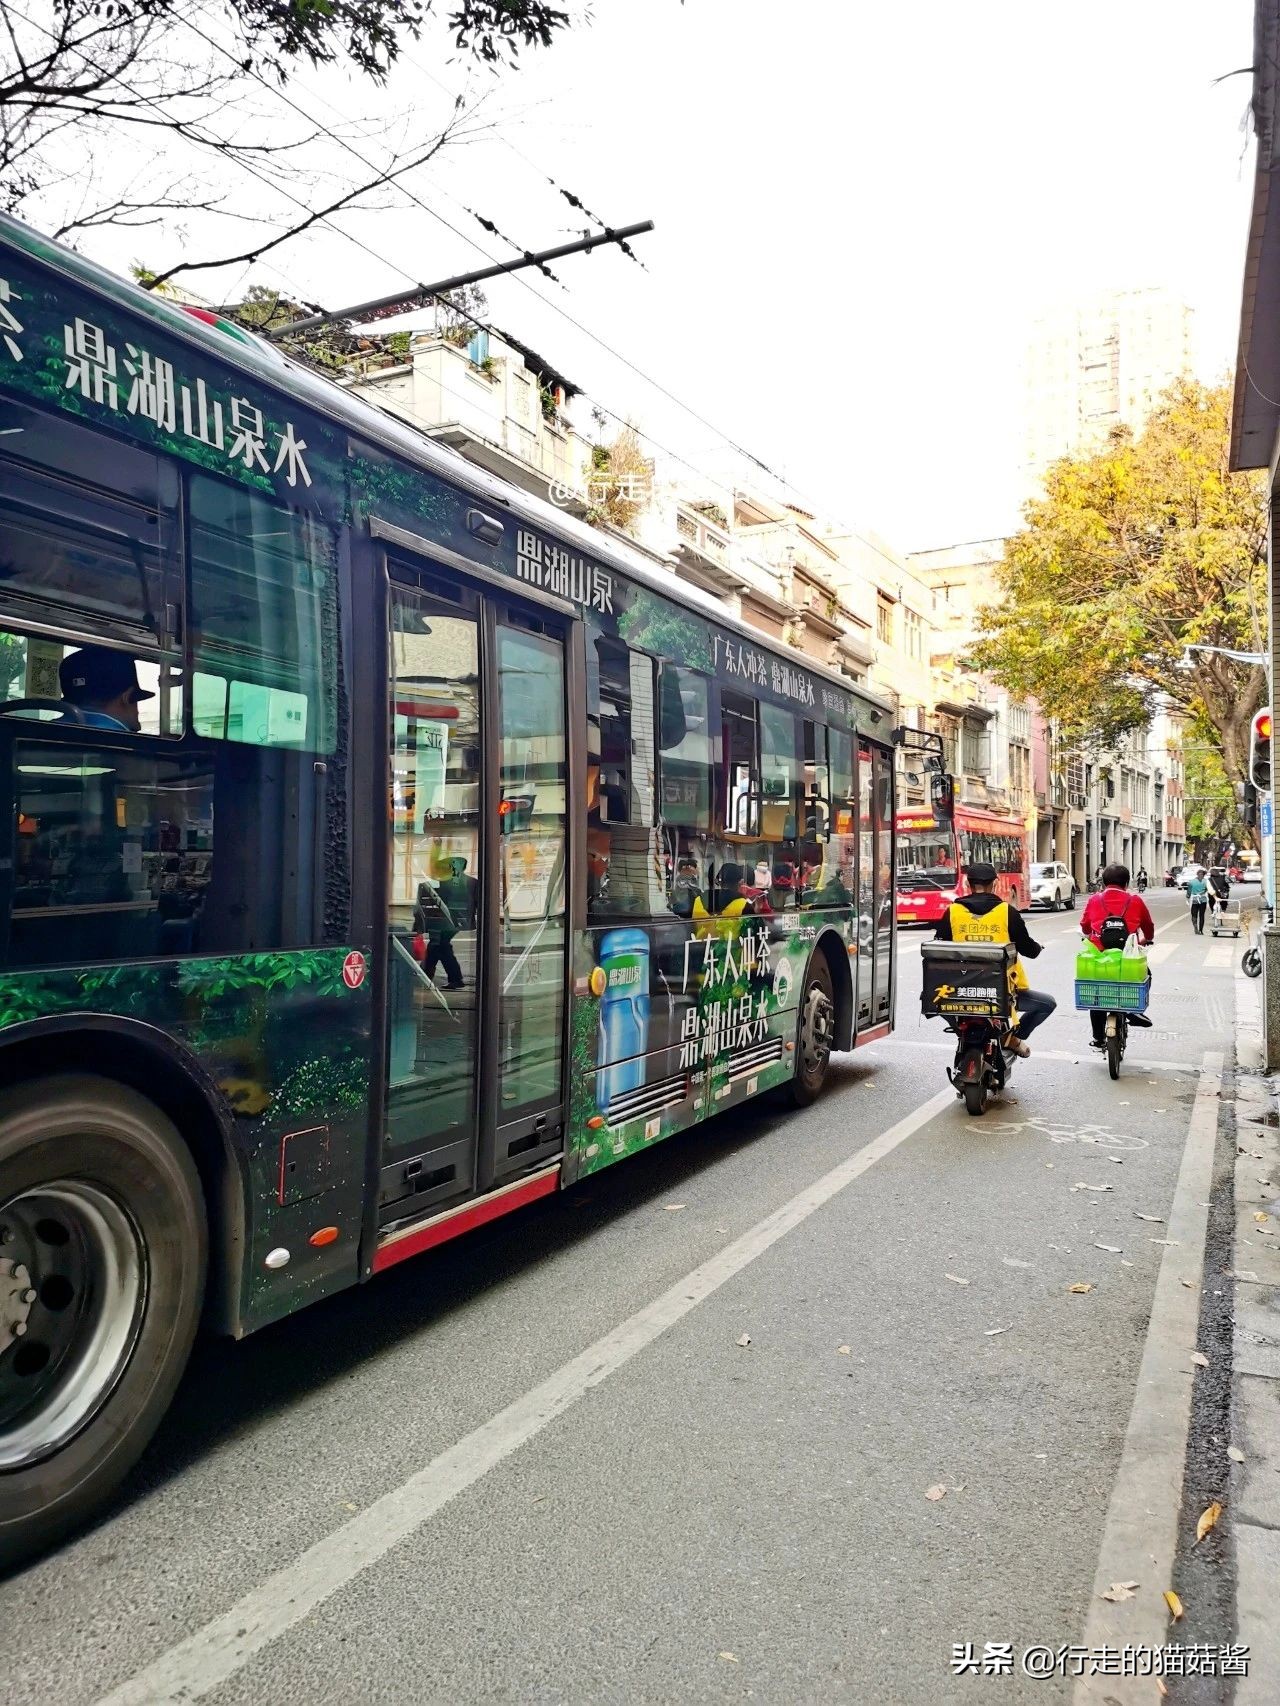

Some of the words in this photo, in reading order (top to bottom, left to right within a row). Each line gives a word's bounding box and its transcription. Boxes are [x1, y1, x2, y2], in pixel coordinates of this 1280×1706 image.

[64, 317, 312, 488] 鼎湖山泉水
[516, 530, 613, 615] 鼎湖山泉
[713, 634, 767, 687] 广东人冲茶
[771, 661, 815, 707] 鼎湖山泉水
[683, 926, 771, 995] 广东人冲茶
[959, 923, 1001, 934] 美团外卖
[957, 986, 998, 998] 美团跑腿
[680, 989, 769, 1070] 鼎湖山泉水
